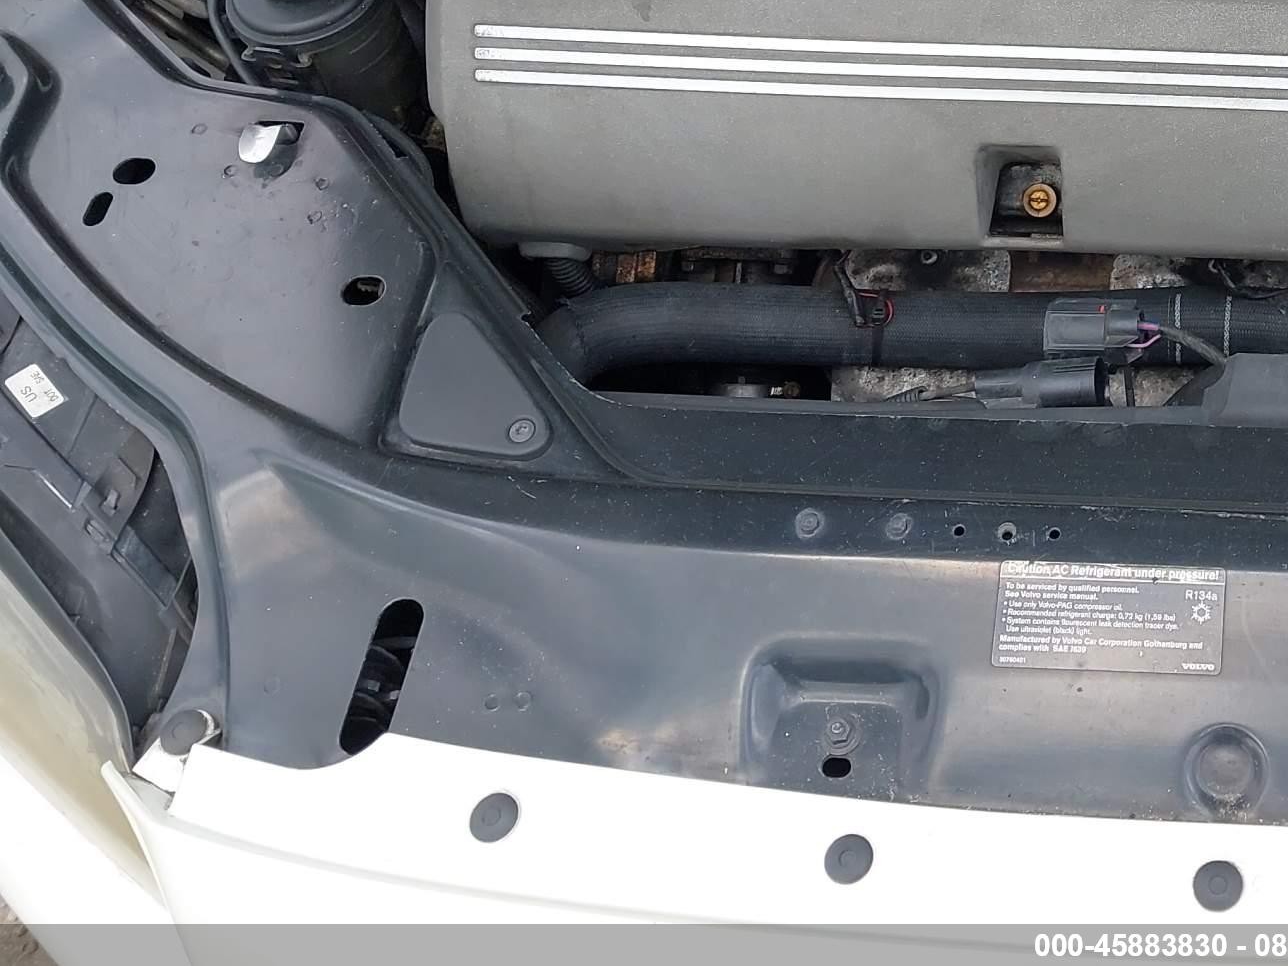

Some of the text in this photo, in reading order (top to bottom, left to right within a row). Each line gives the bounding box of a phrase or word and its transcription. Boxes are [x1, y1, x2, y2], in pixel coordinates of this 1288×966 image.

[20, 386, 38, 403] US
[1071, 564, 1134, 578] Refrigerant
[1135, 568, 1166, 578] under
[1027, 583, 1056, 591] serviced
[1058, 584, 1066, 592] by
[1068, 584, 1100, 592] qualified
[1186, 590, 1218, 601] R134a
[1000, 634, 1050, 644] Manufactured
[1052, 636, 1061, 644] by
[1062, 636, 1082, 644] Volvo
[1098, 638, 1142, 648] Corporation
[1182, 663, 1215, 671] VOLVO
